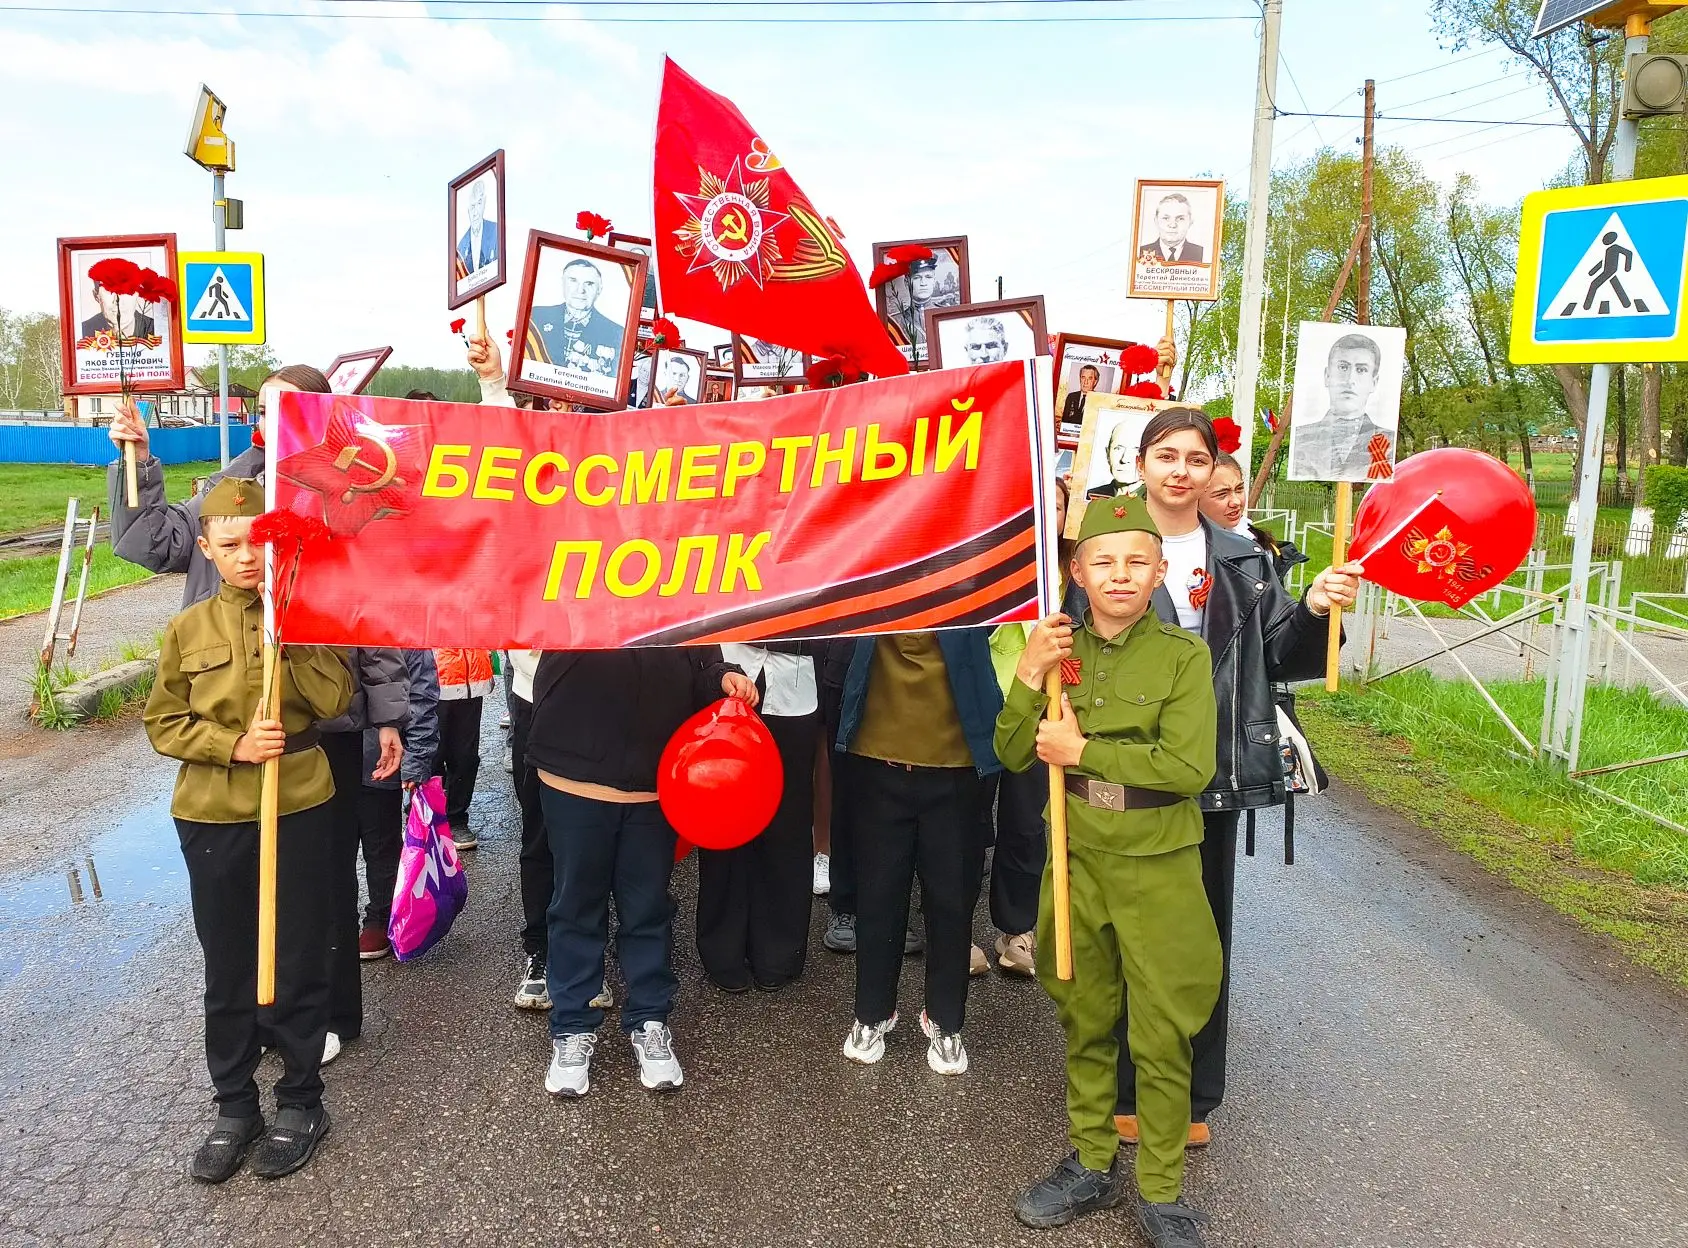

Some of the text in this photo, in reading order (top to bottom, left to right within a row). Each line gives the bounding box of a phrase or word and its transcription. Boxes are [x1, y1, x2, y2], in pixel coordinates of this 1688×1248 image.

[703, 194, 757, 251] ОТЕЧЕСТВЕННАЯ
[110, 358, 163, 366] СТЕПАНОВИЧ
[80, 372, 145, 380] БЕССМЕРНЫЙ
[528, 372, 563, 385] Василий
[422, 398, 982, 507] БЕССМЕРТНЫЙ
[543, 531, 771, 600] ПОЛК
[1447, 578, 1464, 592] 1941
[1443, 589, 1461, 603] 1945
